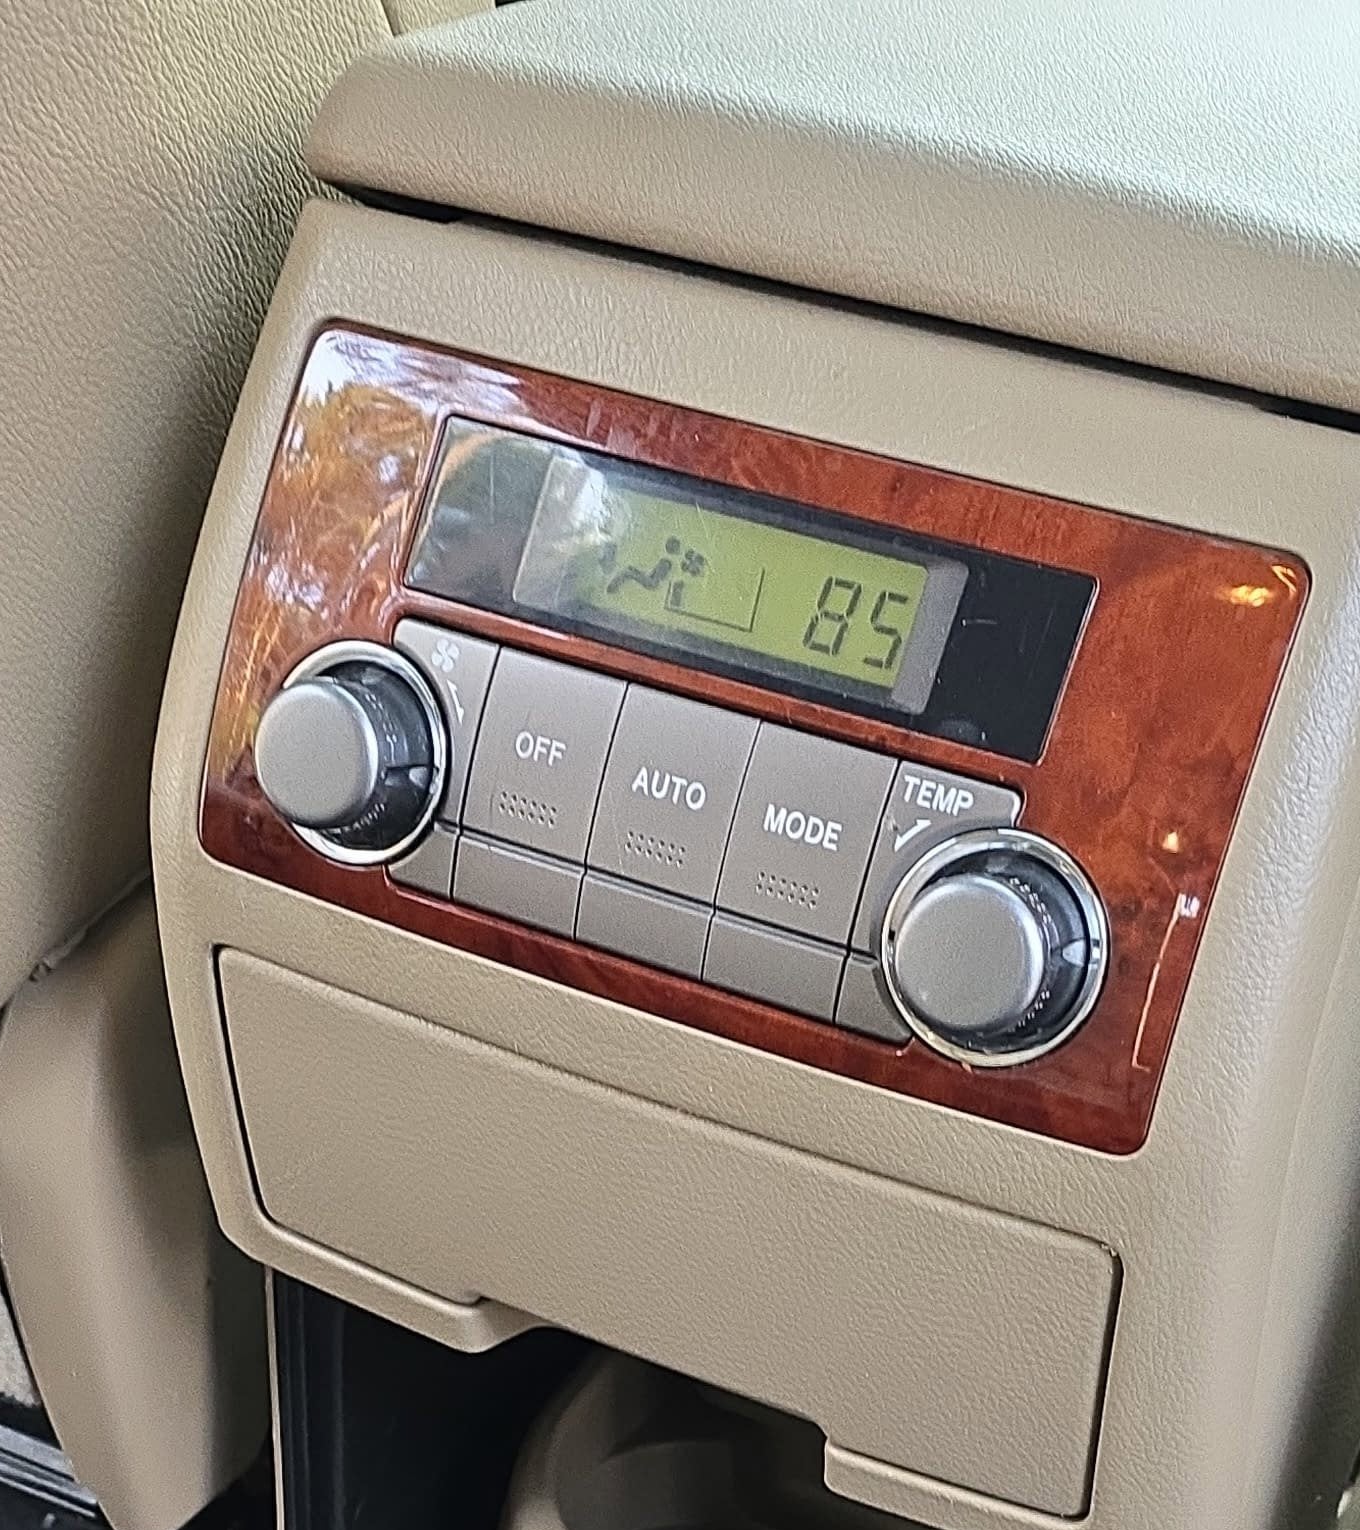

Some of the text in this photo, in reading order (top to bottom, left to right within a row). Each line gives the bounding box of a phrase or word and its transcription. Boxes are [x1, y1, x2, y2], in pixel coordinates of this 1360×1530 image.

[802, 574, 909, 670] 85
[515, 731, 566, 766] OFF
[631, 766, 707, 811] AUTO
[902, 775, 974, 817] TEMP
[763, 803, 843, 850] MODE
